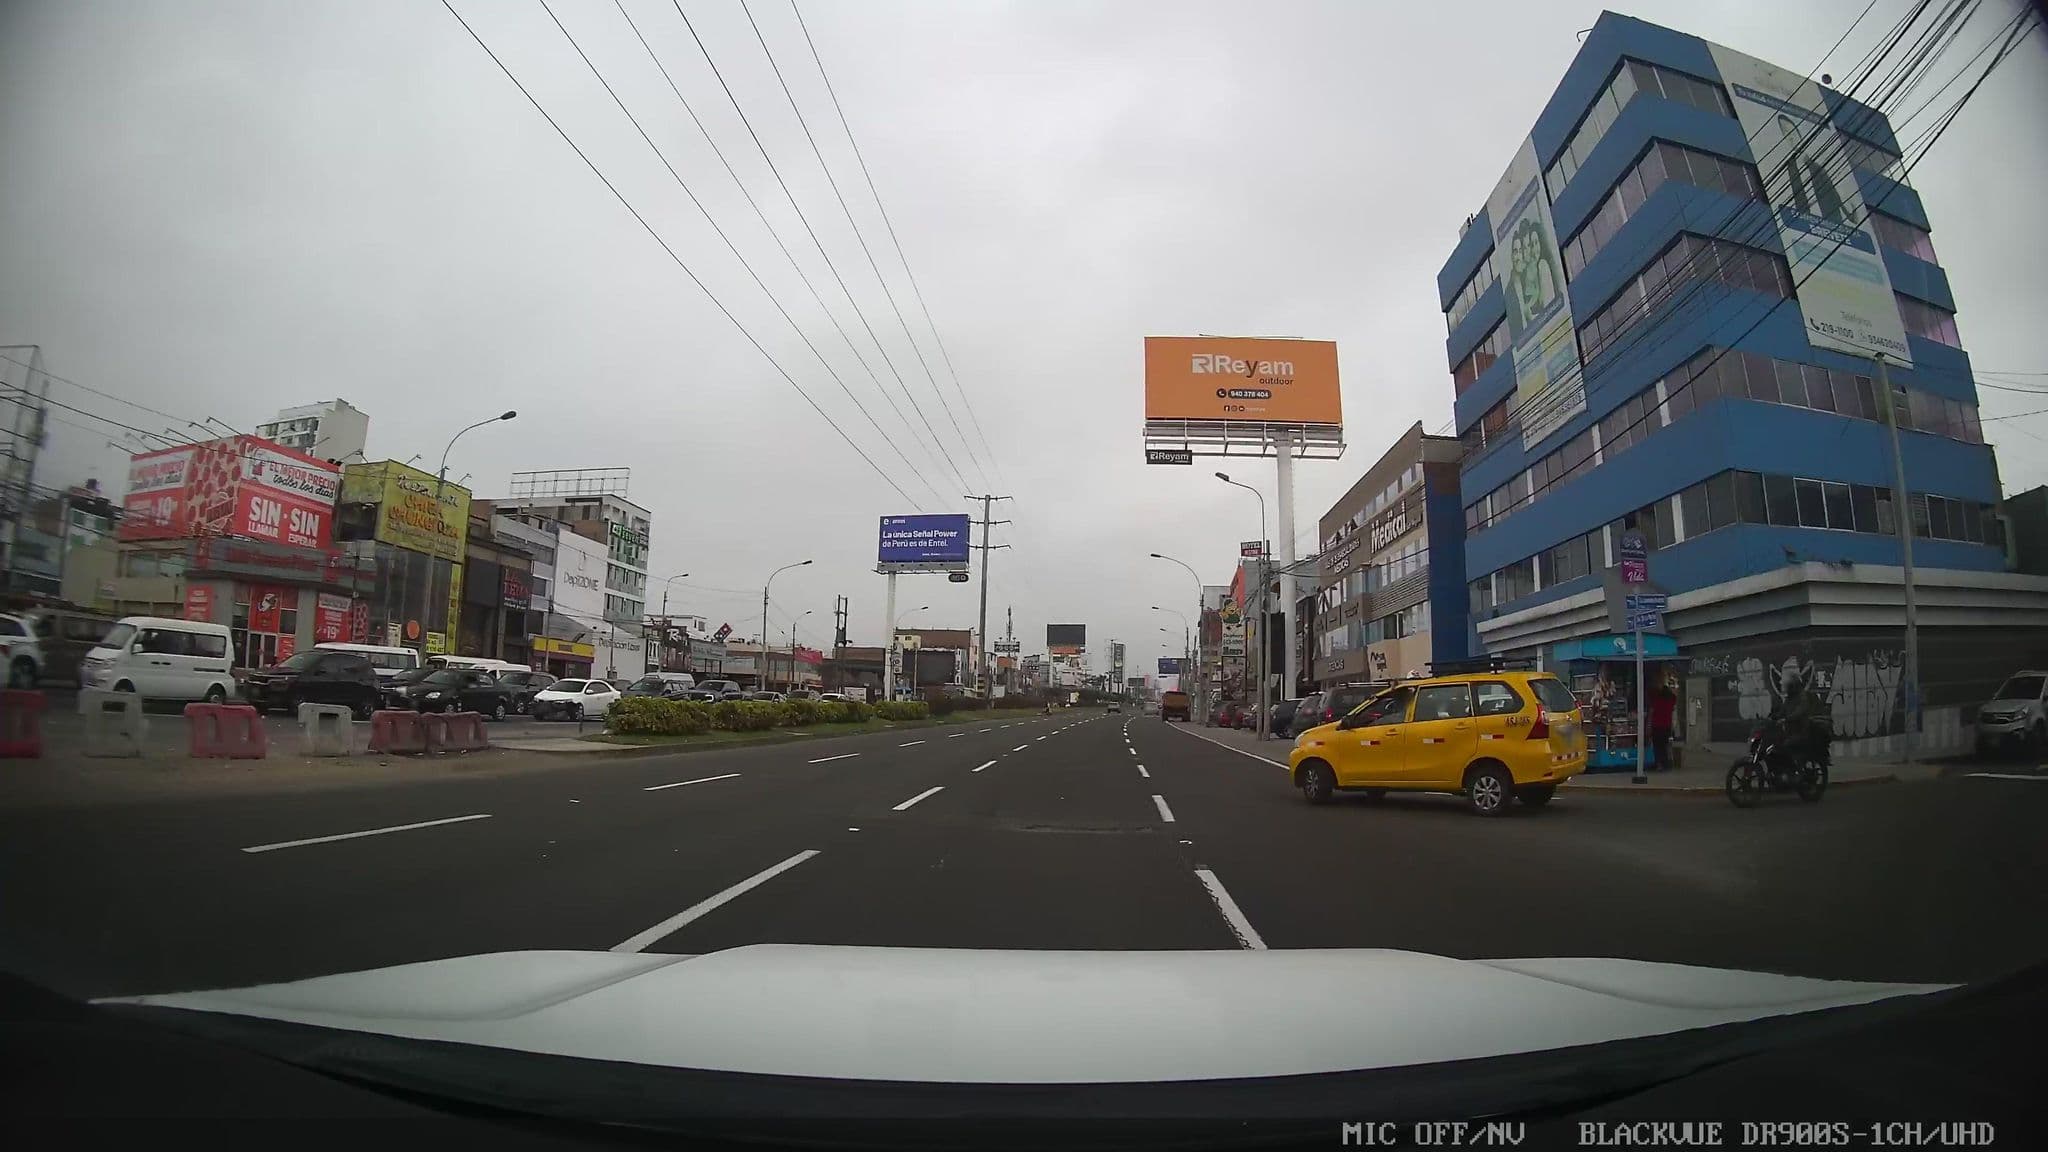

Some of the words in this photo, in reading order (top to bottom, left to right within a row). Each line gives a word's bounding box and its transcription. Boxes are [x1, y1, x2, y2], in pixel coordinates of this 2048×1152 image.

[1215, 355, 1294, 378] Reyam
[1258, 377, 1294, 386] outdoor
[1230, 390, 1243, 398] 940
[1158, 452, 1190, 463] Reyam
[307, 473, 336, 491] PRECIO
[250, 496, 282, 527] SIN
[289, 508, 319, 538] SIN
[247, 521, 278, 539] LLAMAR
[882, 531, 892, 539] La
[893, 530, 913, 538] única
[912, 530, 933, 538] Señal
[934, 529, 958, 538] Power
